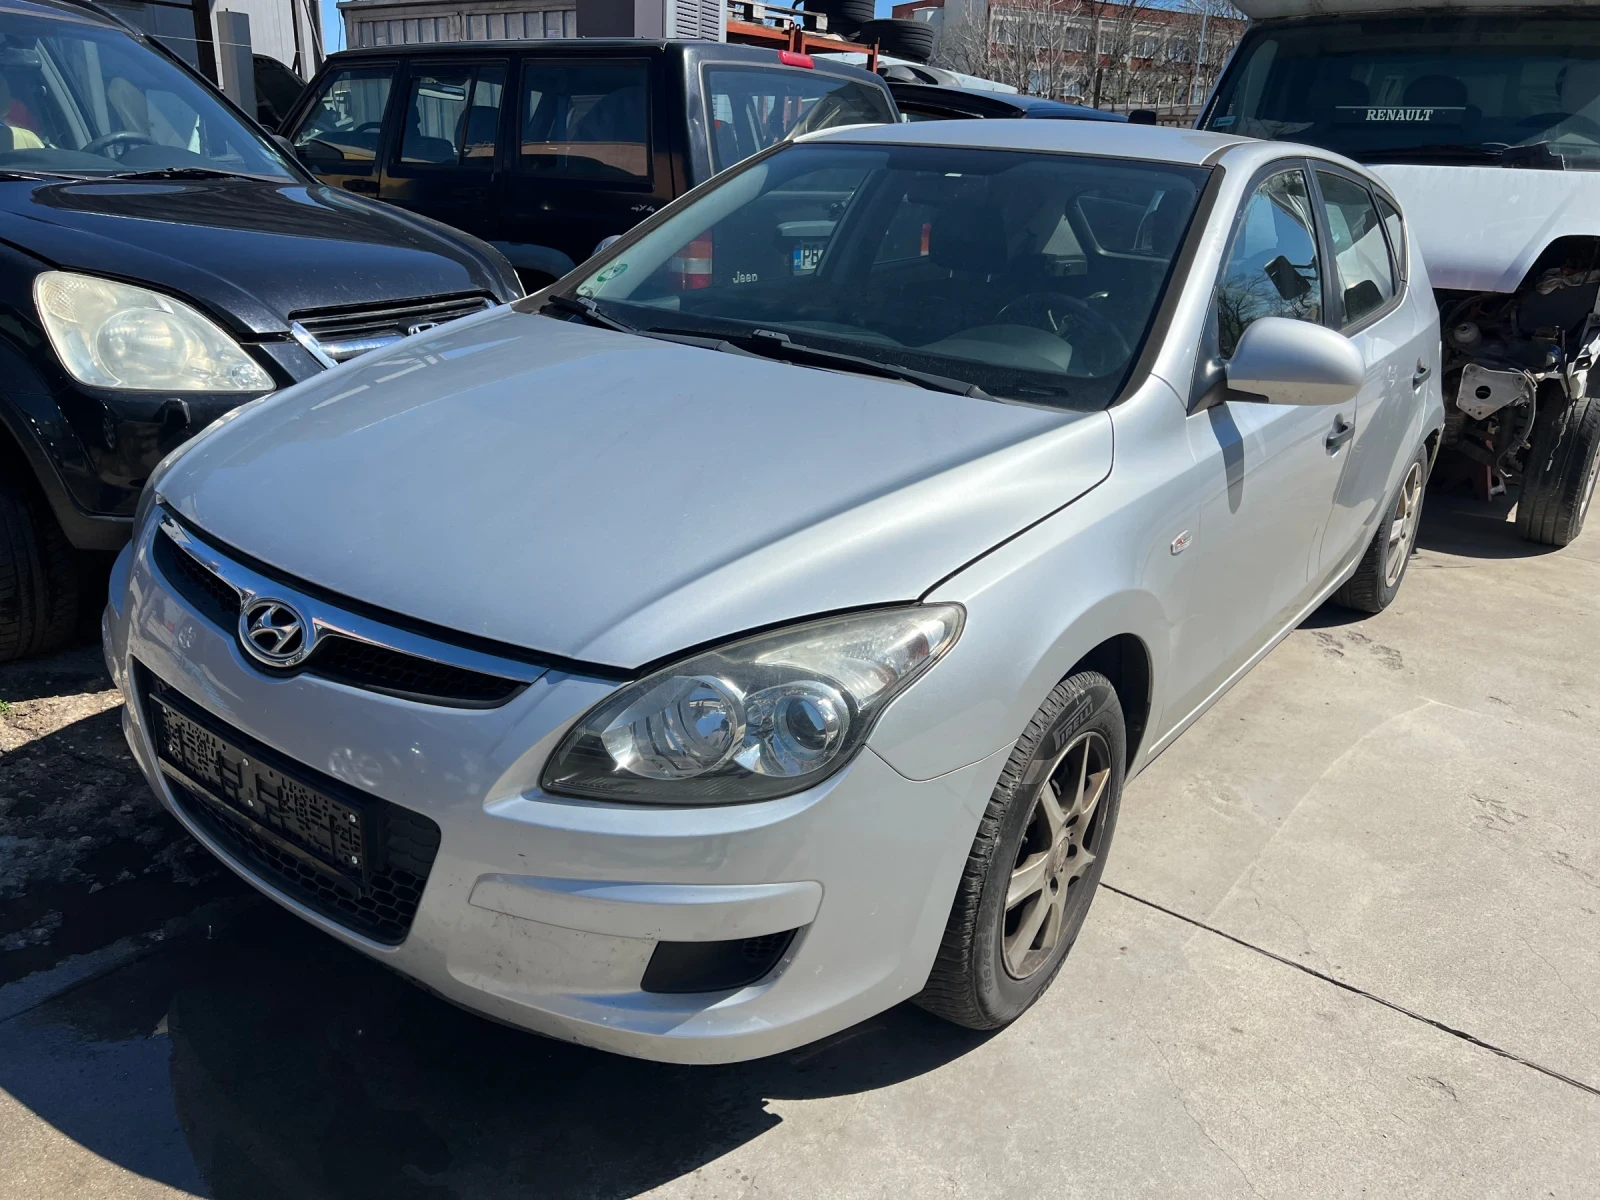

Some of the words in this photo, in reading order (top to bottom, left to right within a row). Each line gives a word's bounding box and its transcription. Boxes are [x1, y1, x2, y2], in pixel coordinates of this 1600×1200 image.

[1365, 109, 1434, 121] RENAULT
[732, 271, 758, 284] Jeep
[1053, 694, 1094, 752] PIRELLI
